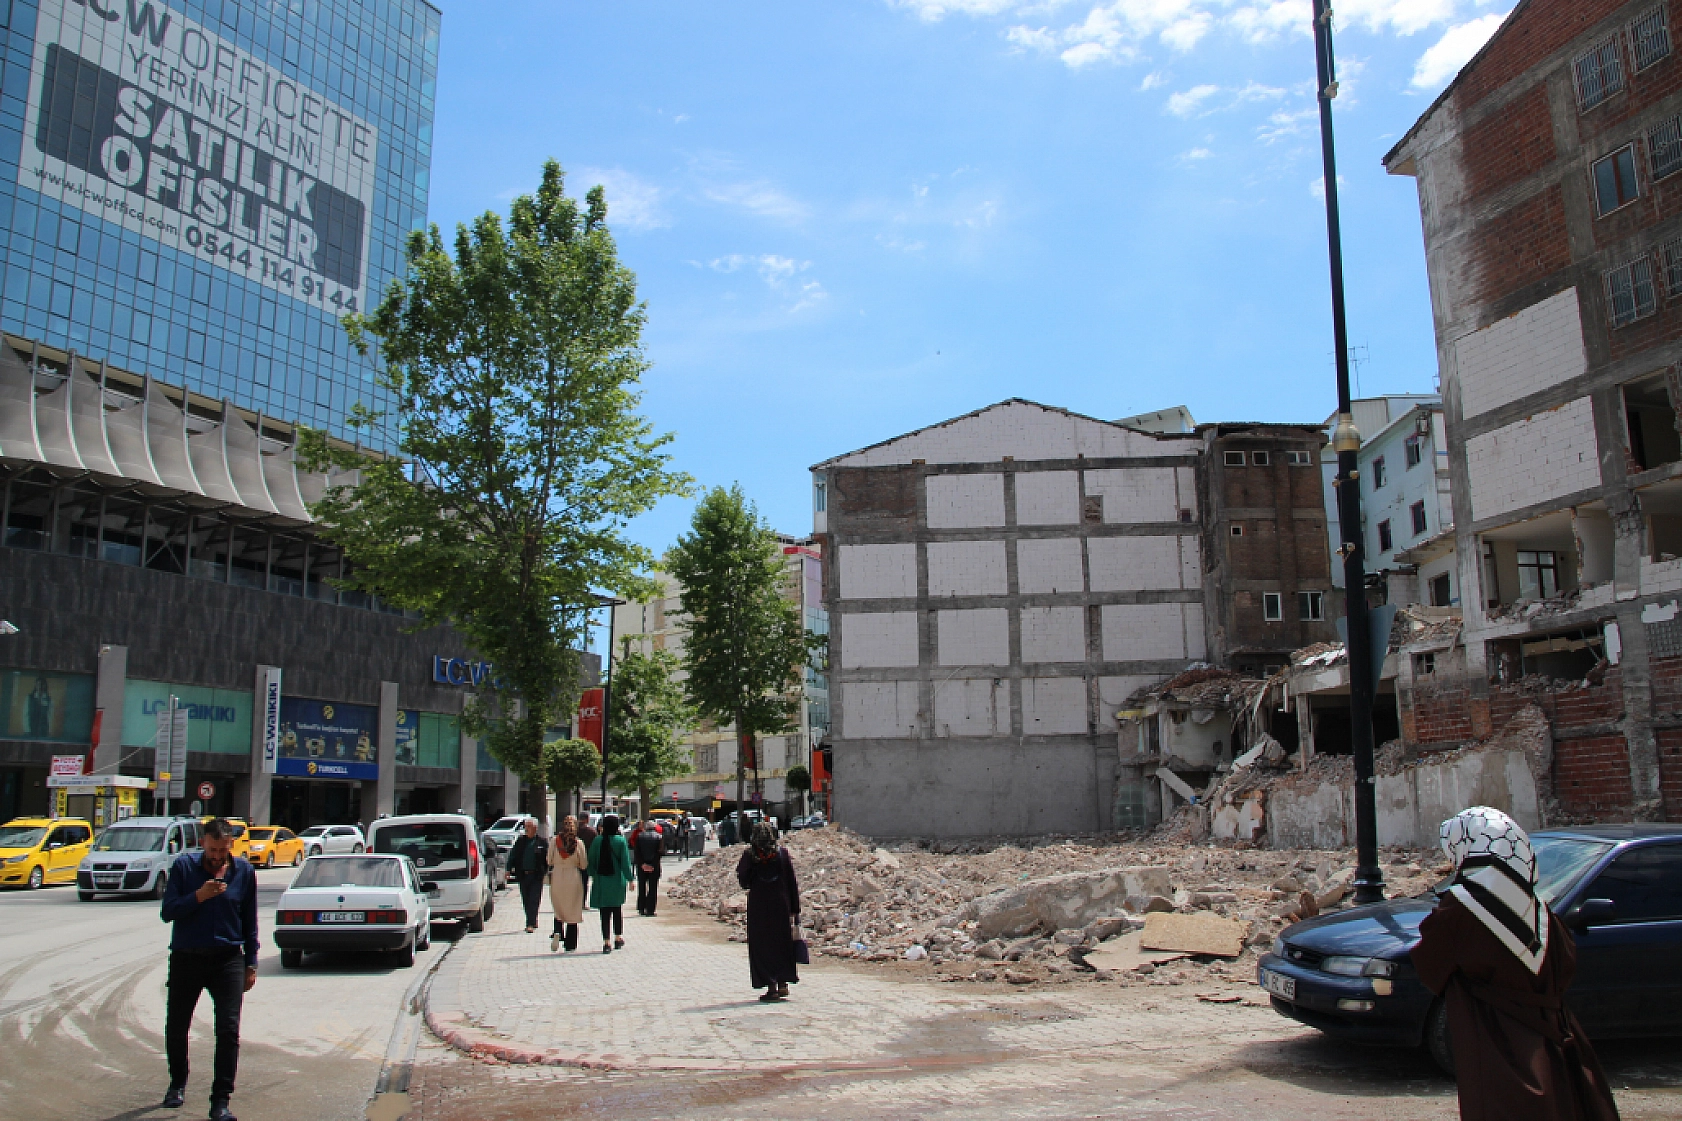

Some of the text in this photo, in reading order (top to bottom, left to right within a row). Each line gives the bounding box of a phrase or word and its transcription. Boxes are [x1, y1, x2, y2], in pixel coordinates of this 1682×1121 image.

[114, 87, 317, 221] SATILIK
[183, 28, 372, 163] OFFICE'TE
[34, 167, 358, 313] www.lcwoffice.com 0544 114 91 44
[101, 135, 318, 271] OFİSLER
[265, 742, 275, 760] LC
